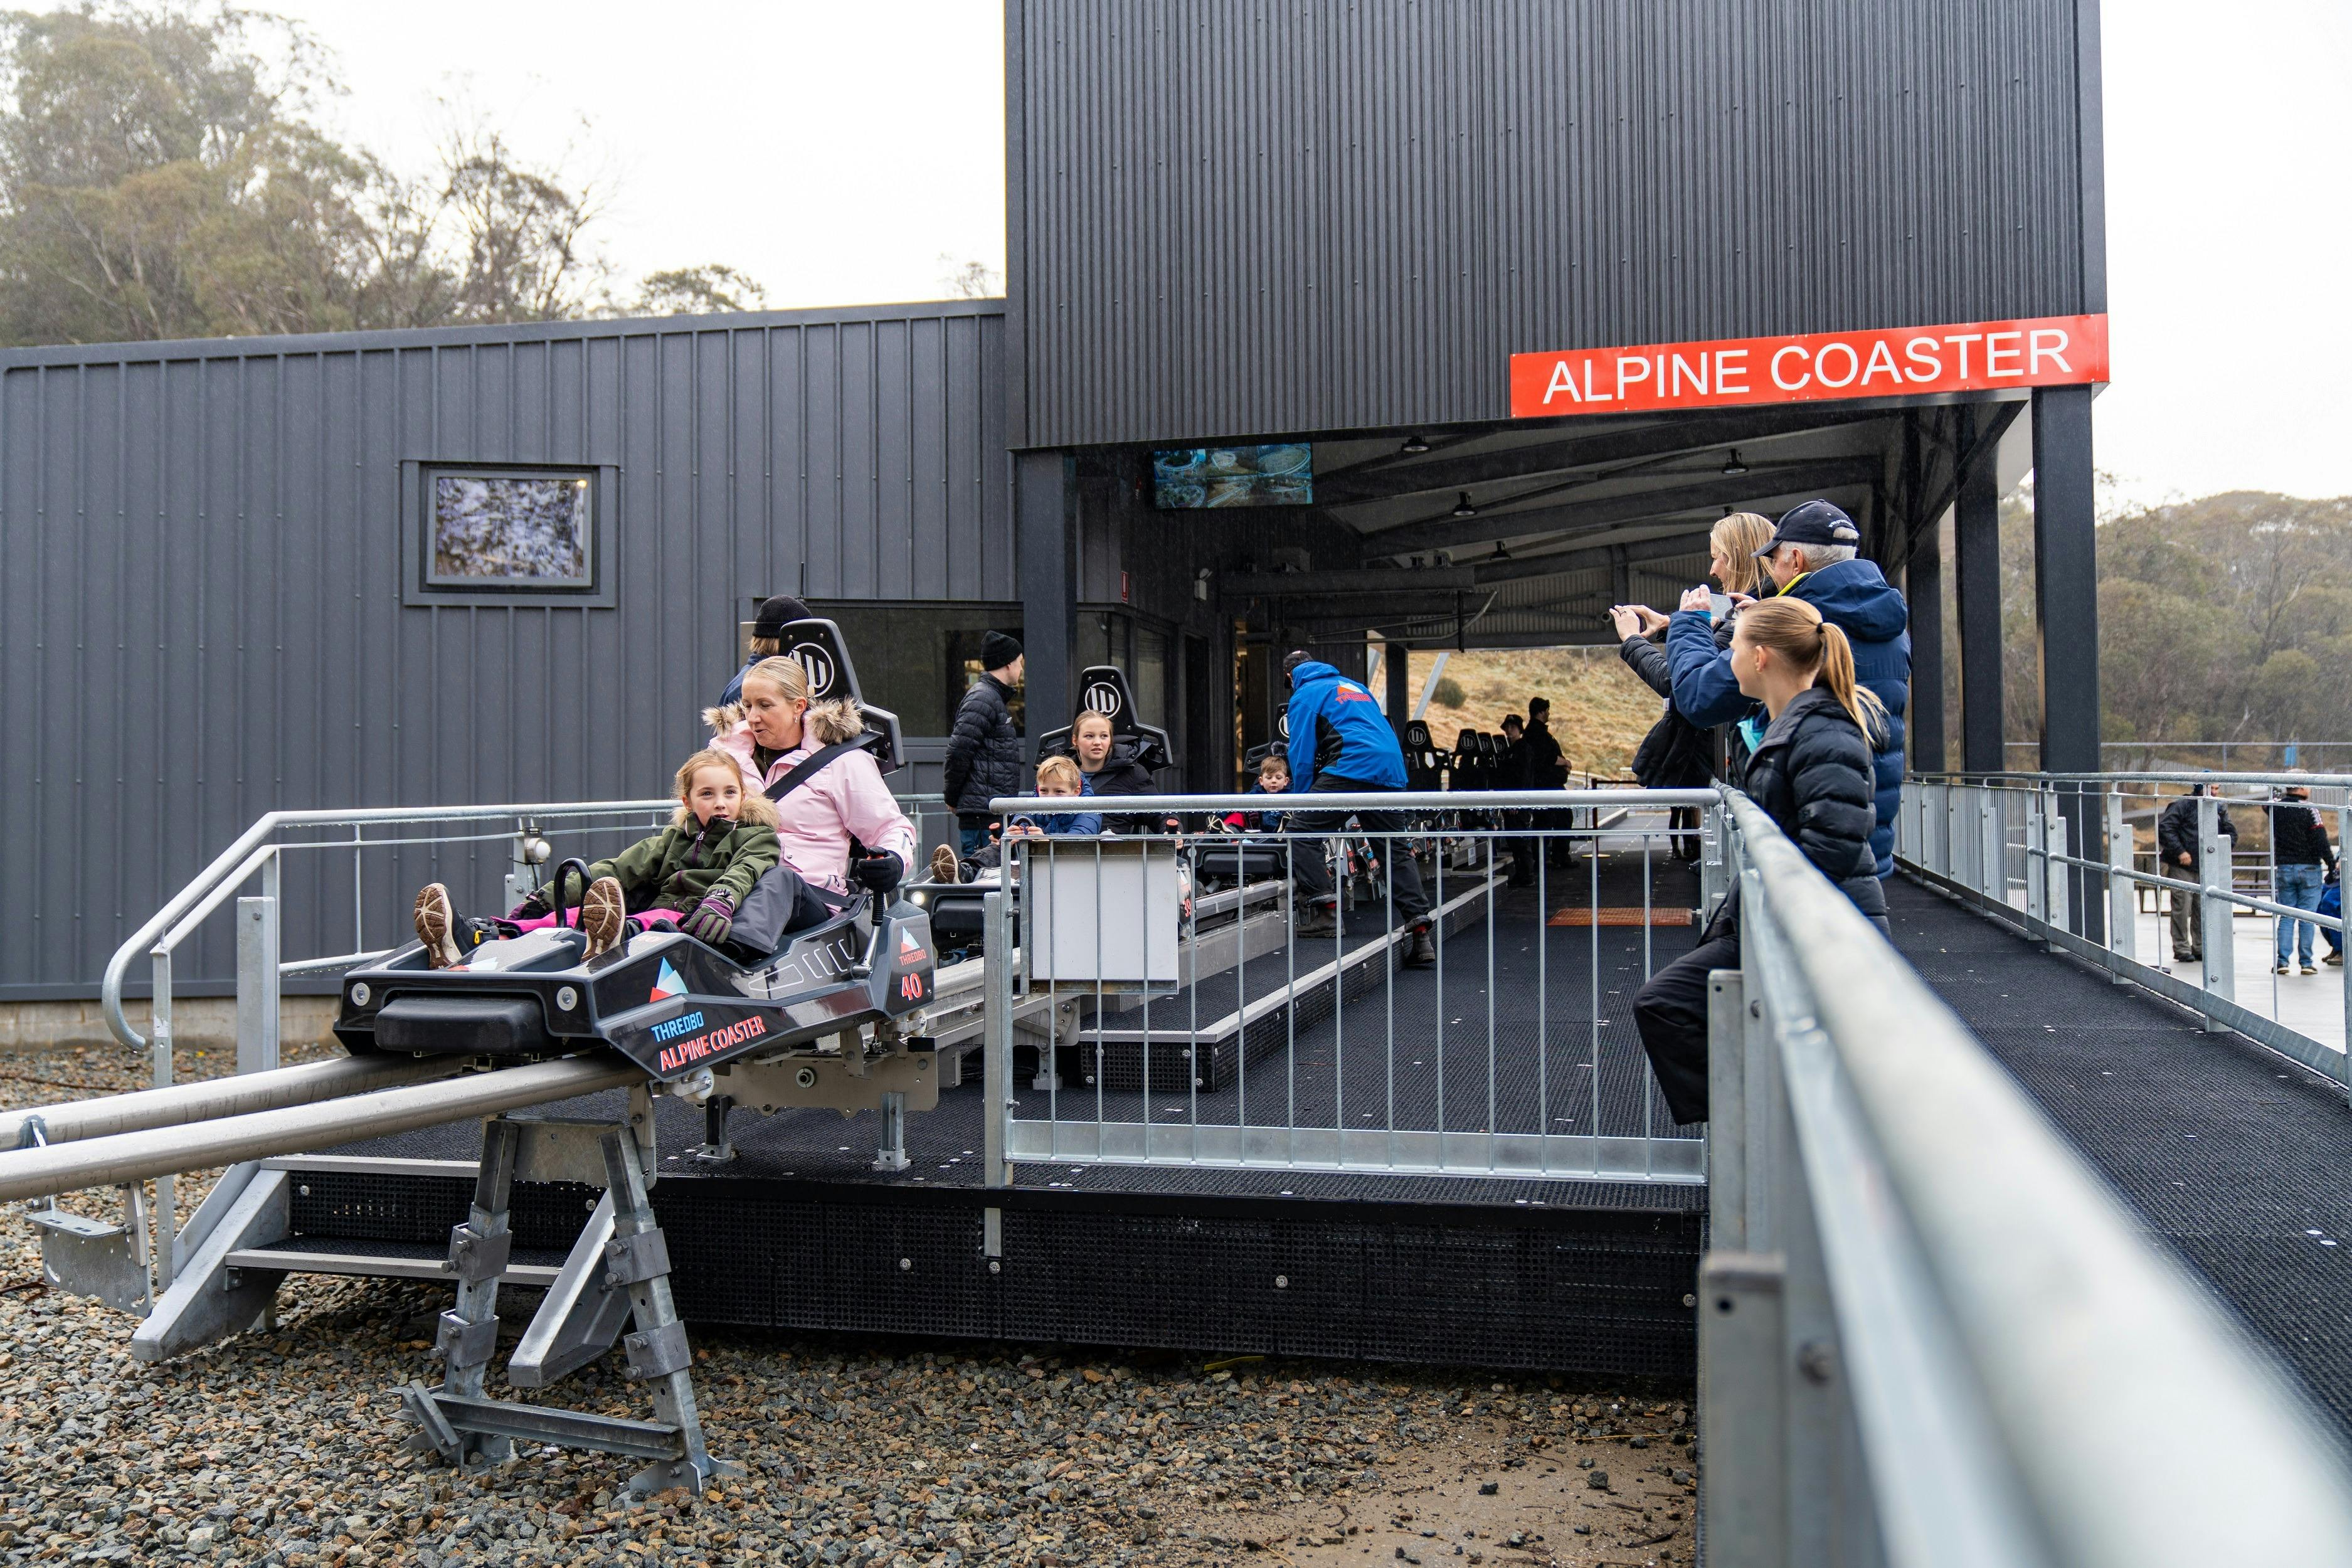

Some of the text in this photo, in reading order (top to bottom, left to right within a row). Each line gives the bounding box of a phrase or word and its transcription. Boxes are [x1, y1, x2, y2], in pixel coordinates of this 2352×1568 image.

[1542, 329, 2072, 405] ALPINE COASTER
[899, 949, 926, 966] THREDBO
[901, 973, 923, 1001] 40
[651, 1011, 704, 1042] THREDBO
[660, 1015, 766, 1072] ALPINE COASTER
